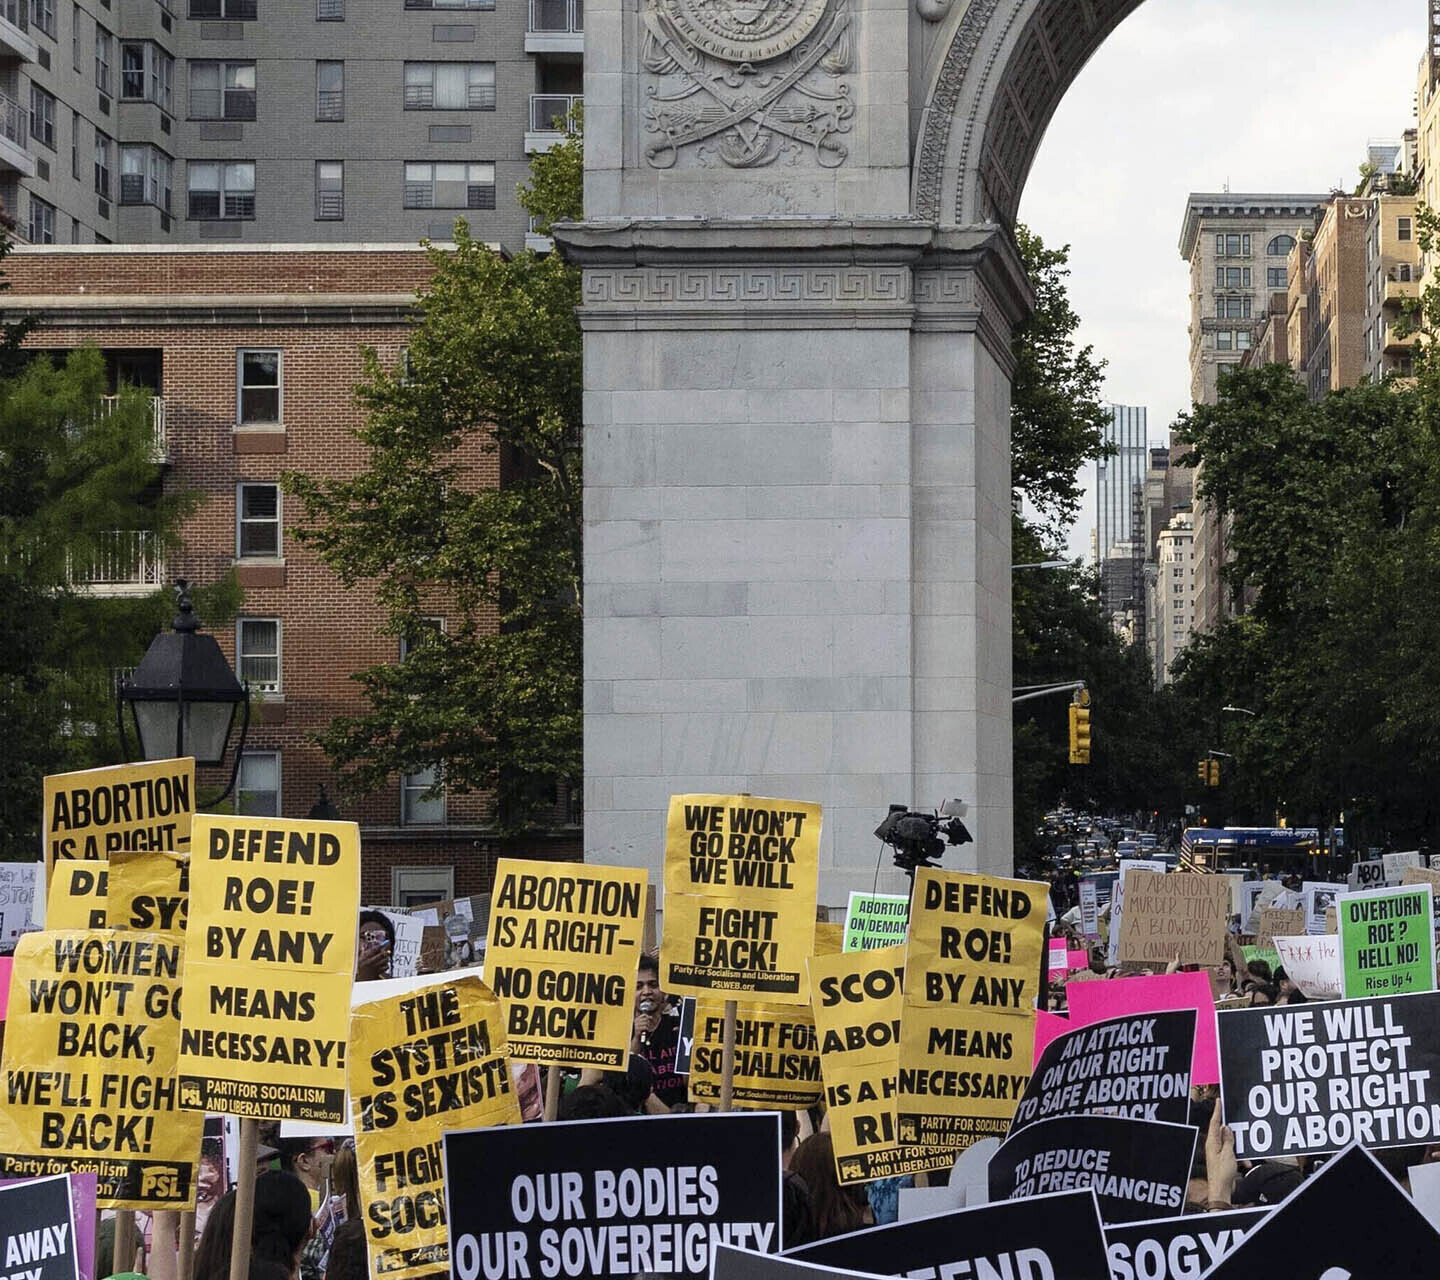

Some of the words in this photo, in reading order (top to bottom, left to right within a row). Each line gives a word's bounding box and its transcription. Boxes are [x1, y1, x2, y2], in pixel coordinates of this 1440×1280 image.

[685, 805, 724, 832] WE
[729, 808, 807, 837] WON'T
[209, 827, 341, 865] DEFEND
[691, 832, 723, 857] GO
[728, 833, 796, 863] BACK
[690, 857, 728, 885] WE
[733, 860, 794, 889] WILL
[224, 877, 315, 916] ROE!
[1350, 896, 1421, 922] OVERTURN
[699, 907, 778, 940] FIGHT
[207, 926, 246, 959] BY
[251, 930, 333, 965] ANY
[694, 937, 779, 971] BACK!
[1358, 947, 1392, 969] HELL
[1397, 942, 1418, 964] NO!
[1366, 977, 1388, 989] Rise
[1392, 974, 1403, 988] Up
[210, 985, 315, 1022] MEANS
[180, 1028, 346, 1068] NECESSARY!
[206, 1080, 239, 1095] PARTY
[240, 1084, 258, 1098] FOR
[261, 1086, 325, 1104] SOCIALISM
[206, 1097, 227, 1111] AND
[230, 1099, 290, 1117] LIBERATION
[300, 1108, 340, 1122] PSLweb.org
